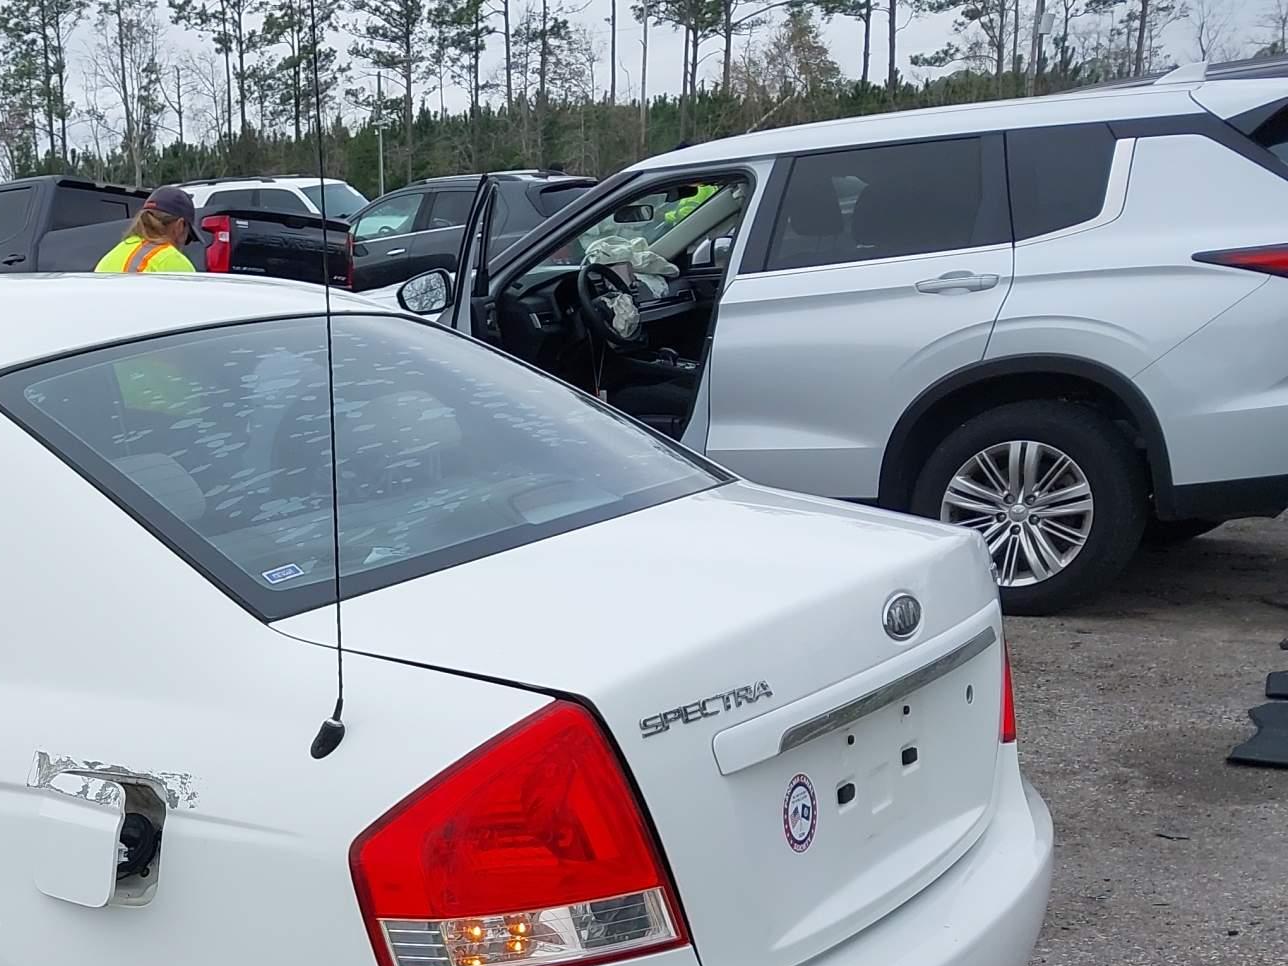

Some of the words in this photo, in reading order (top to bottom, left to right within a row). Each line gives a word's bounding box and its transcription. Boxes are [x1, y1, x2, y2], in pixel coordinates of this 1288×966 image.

[240, 233, 345, 255] EVROET
[890, 600, 919, 632] KIA
[639, 679, 774, 738] SPECTRA
